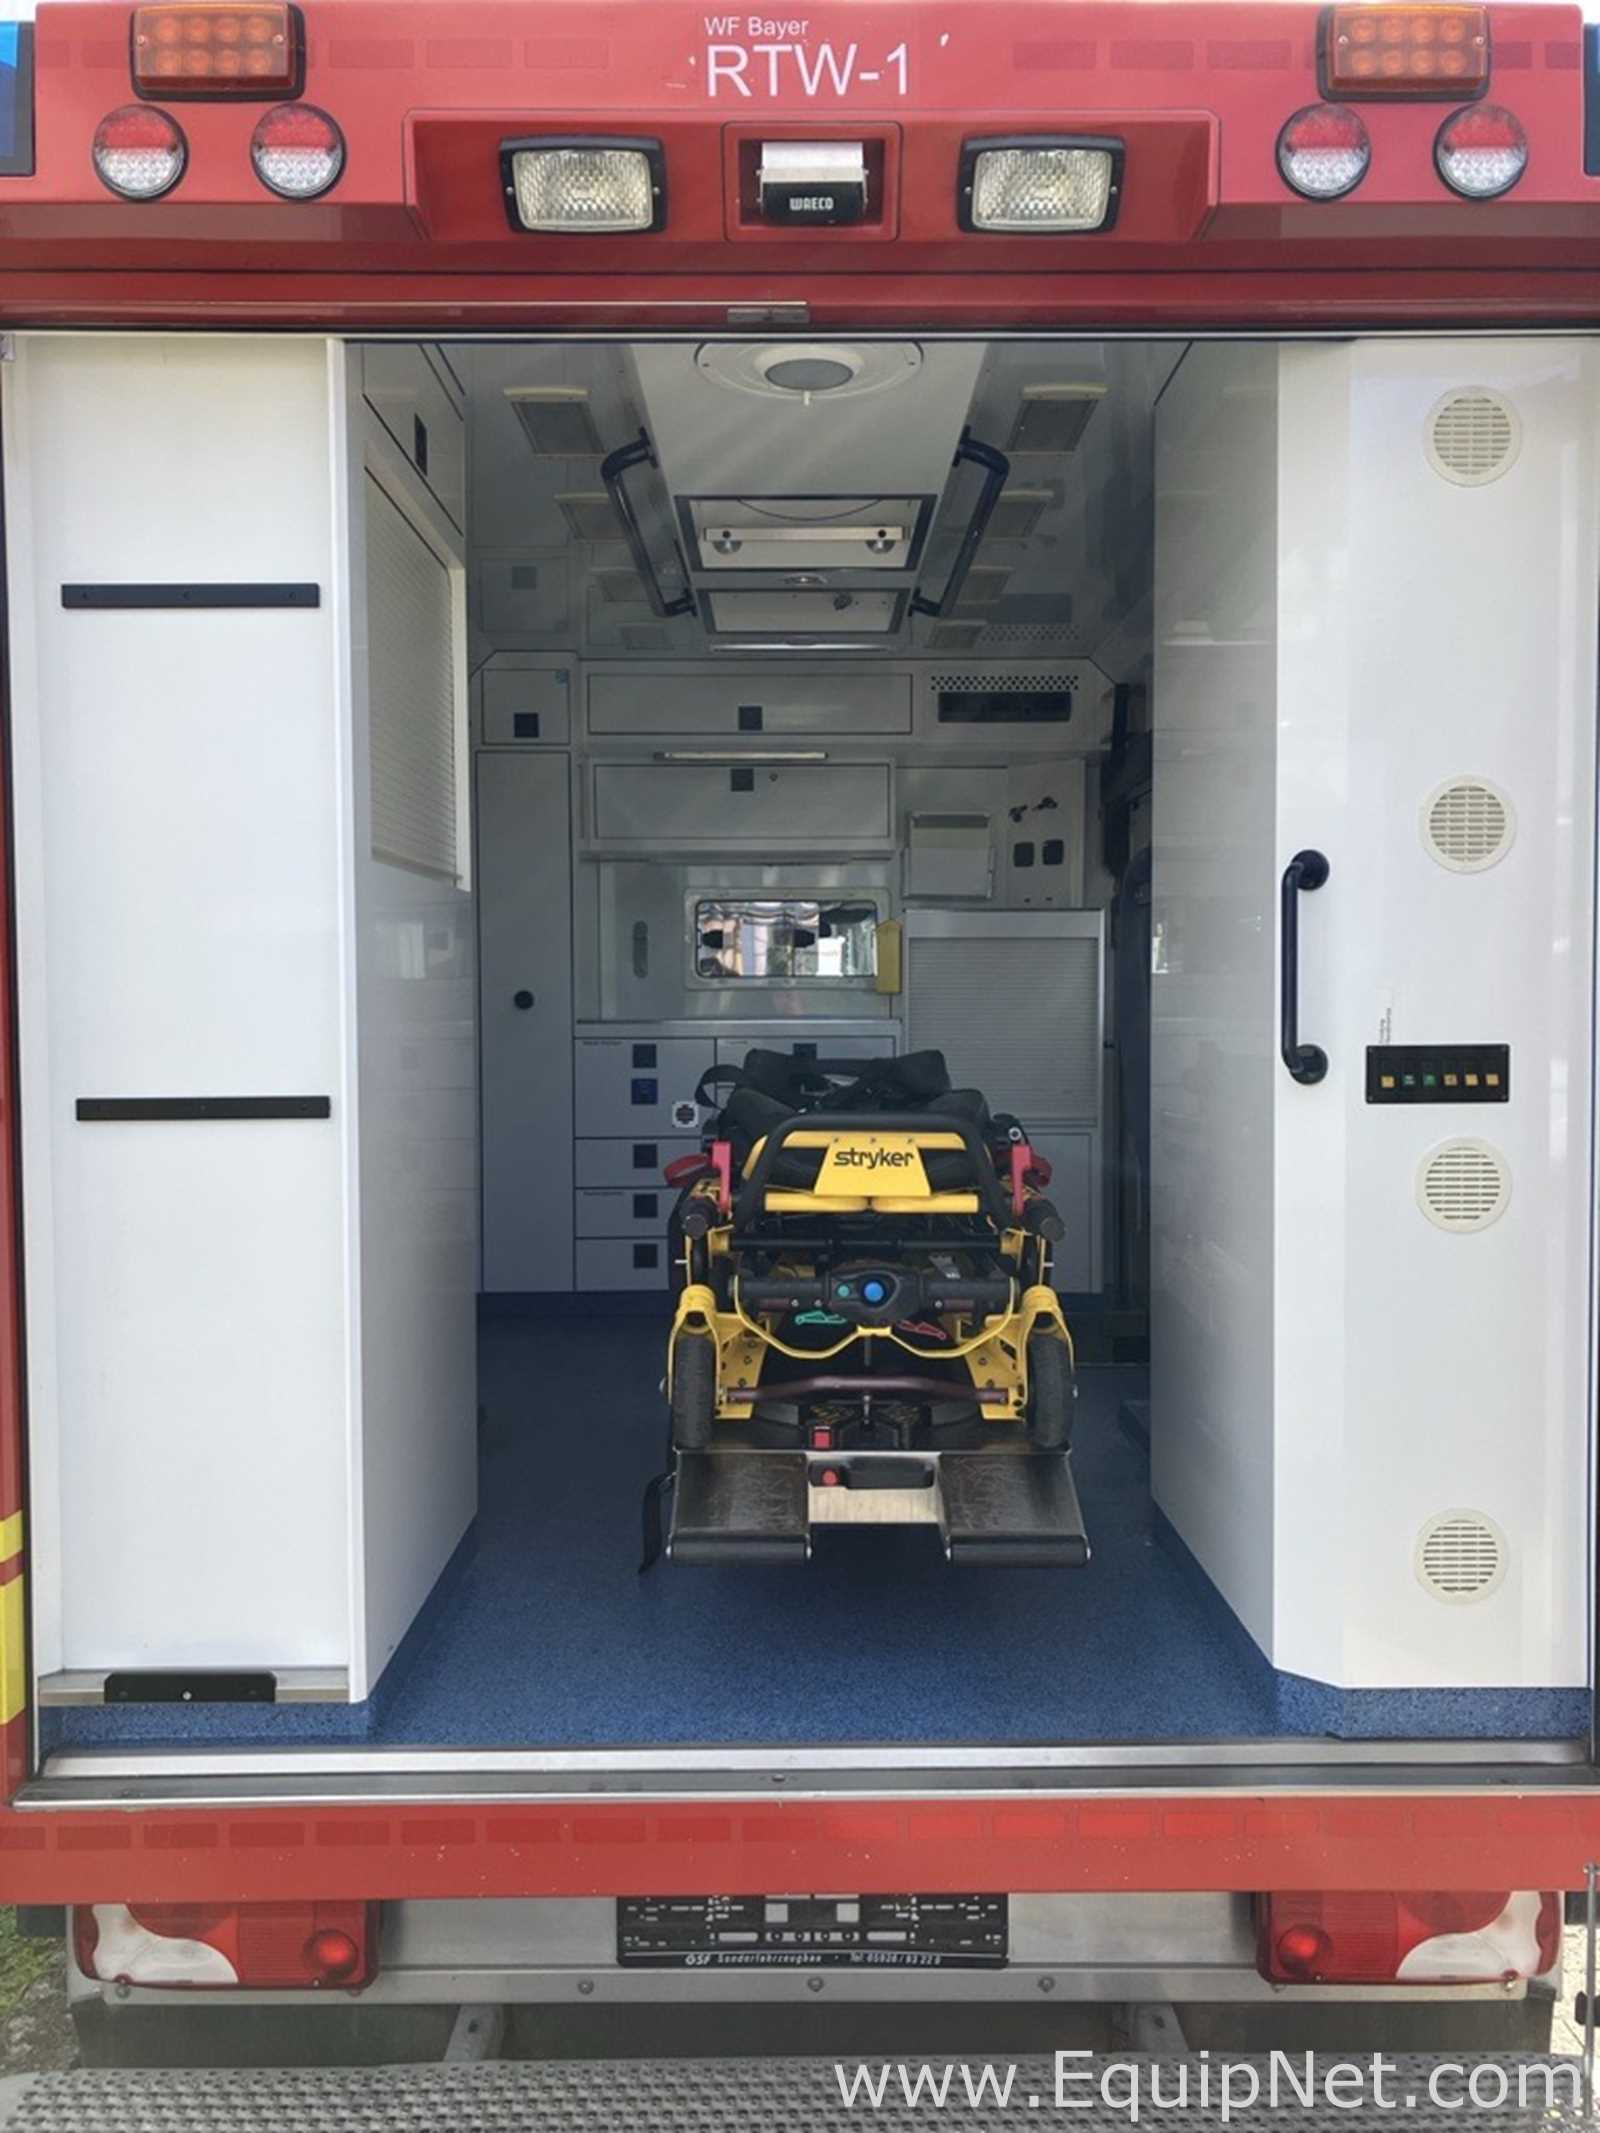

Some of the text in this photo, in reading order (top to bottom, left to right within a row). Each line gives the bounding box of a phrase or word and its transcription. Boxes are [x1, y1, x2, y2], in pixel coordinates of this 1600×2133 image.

[704, 16, 809, 40] WF Bayer
[707, 43, 908, 97] RTW-1
[789, 197, 835, 211] WAECO
[833, 1148, 915, 1170] stryker
